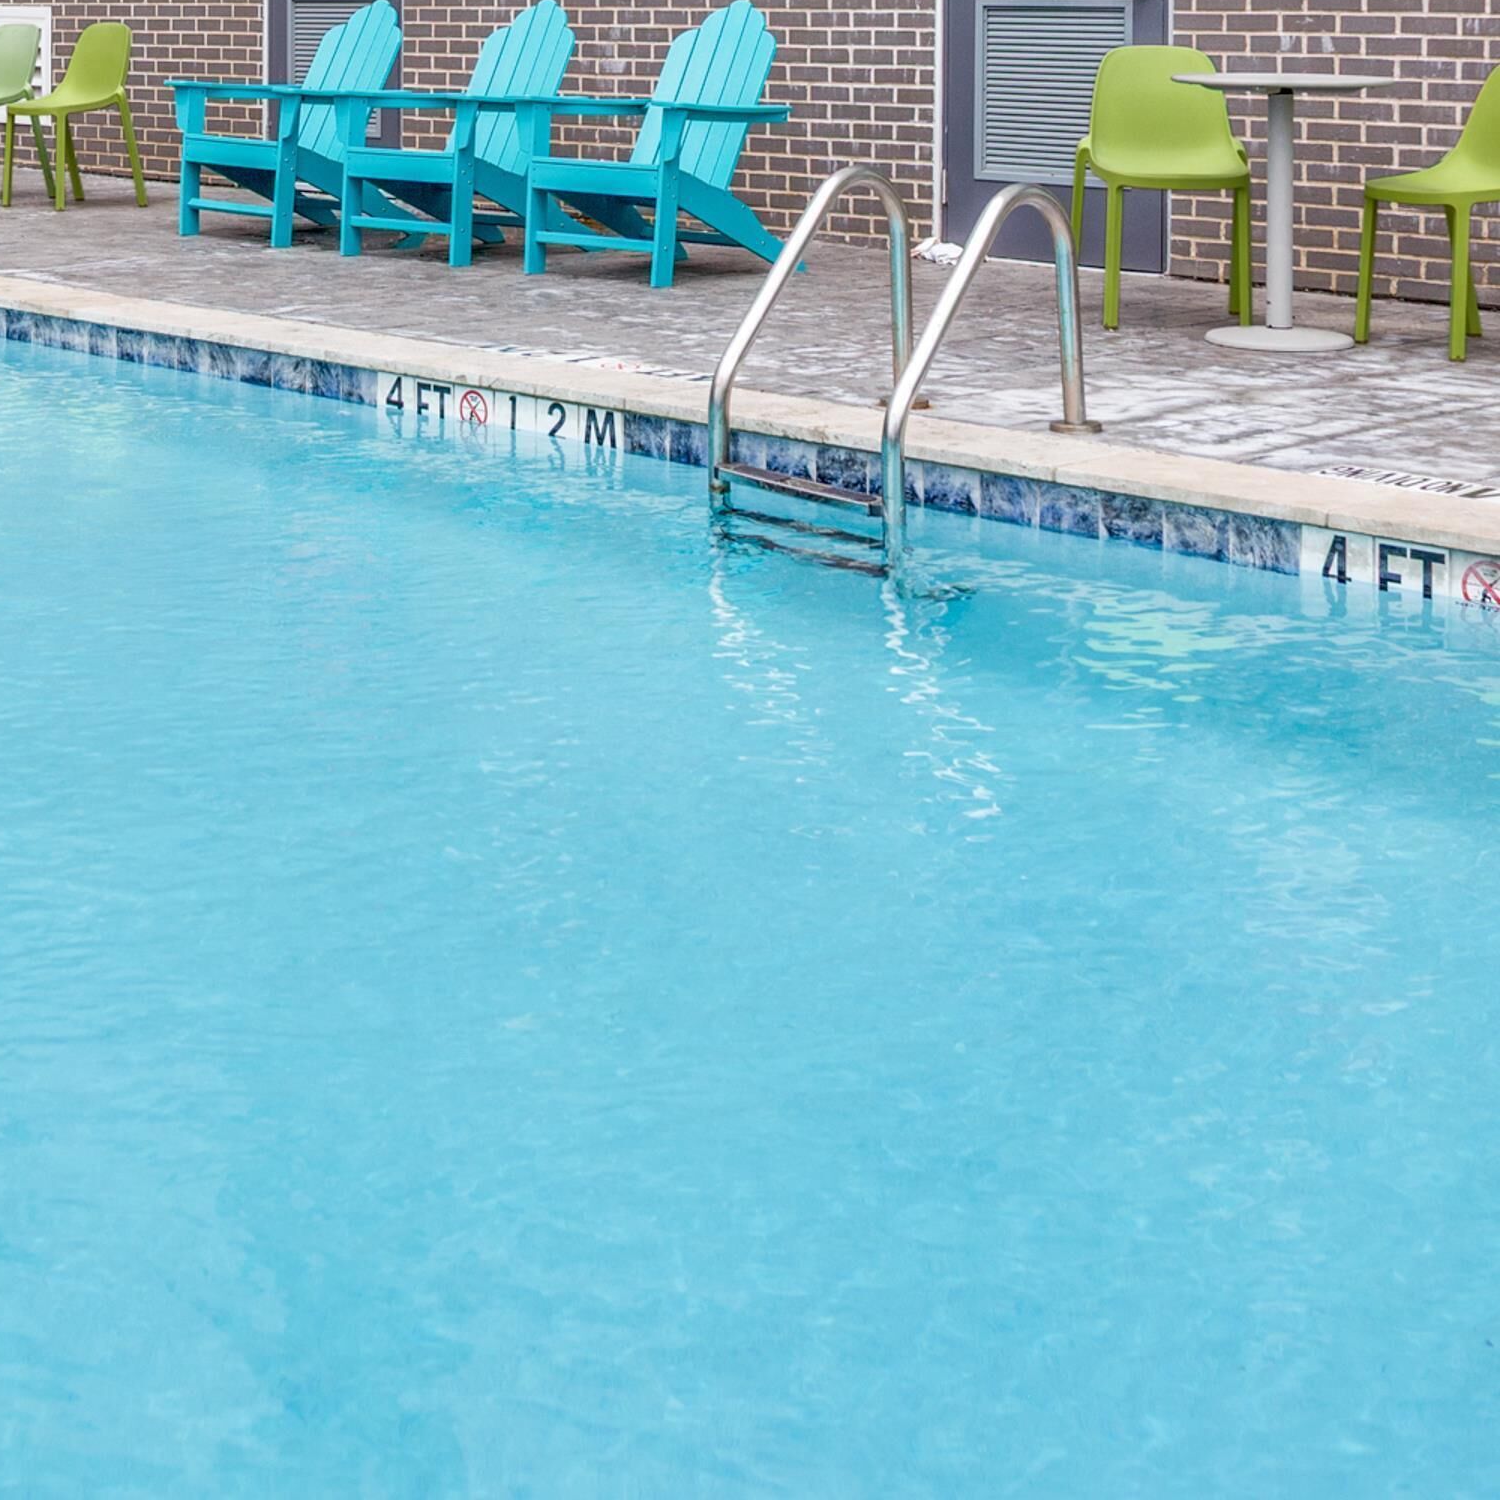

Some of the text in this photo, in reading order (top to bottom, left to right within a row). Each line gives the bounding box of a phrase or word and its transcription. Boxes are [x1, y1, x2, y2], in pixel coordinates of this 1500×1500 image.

[386, 376, 404, 410] 4
[416, 382, 451, 419] FT
[584, 408, 617, 449] M
[1322, 535, 1446, 600] 4 FT
